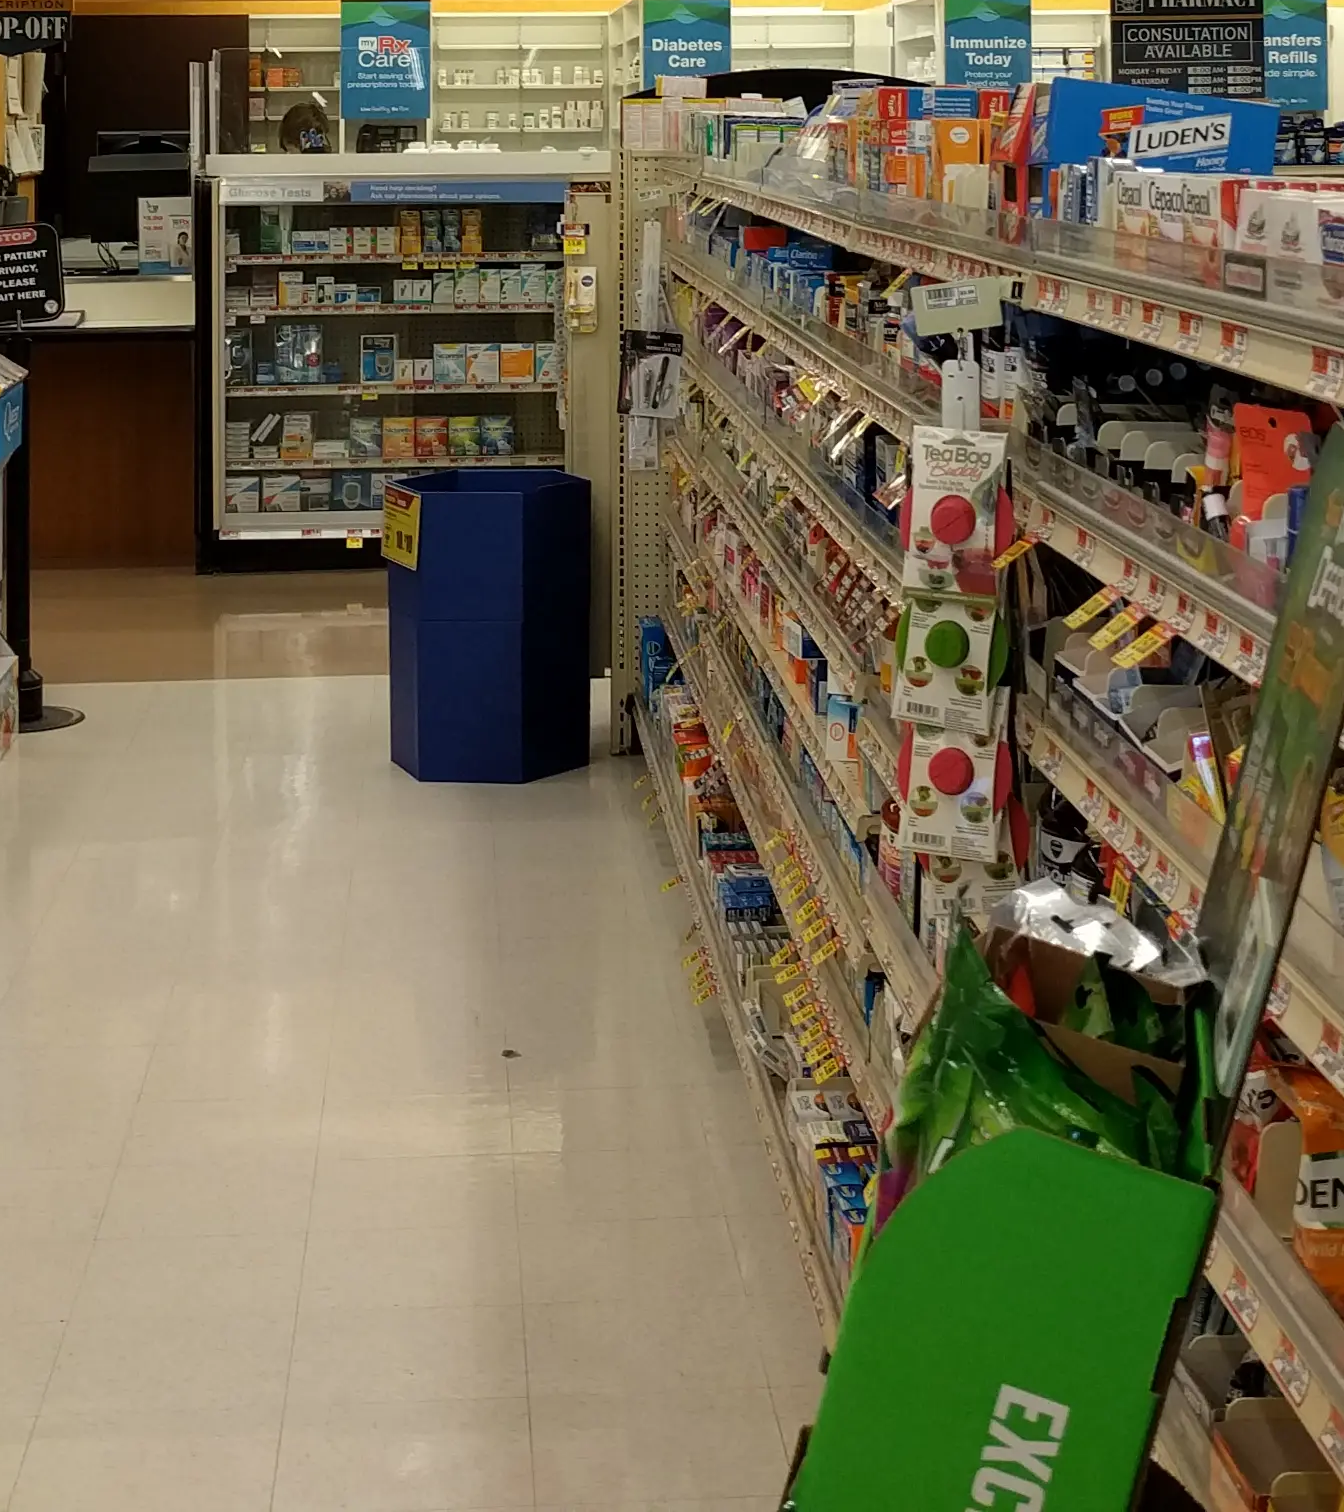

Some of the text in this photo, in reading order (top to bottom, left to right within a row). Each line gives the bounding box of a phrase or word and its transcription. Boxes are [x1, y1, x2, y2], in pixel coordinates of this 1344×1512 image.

[1127, 26, 1249, 42] CONSULTATION
[1264, 34, 1322, 47] ansfers
[377, 35, 412, 55] Rx
[651, 38, 723, 52] Diabetes
[949, 36, 1027, 50] Immunize
[1144, 43, 1233, 59] AVAILABLE
[1268, 50, 1318, 64] Refills
[358, 51, 411, 68] Care
[668, 53, 707, 68] Care
[965, 52, 1012, 68] Today
[964, 71, 1012, 80] Protect your
[1282, 68, 1318, 79] simple.
[1135, 122, 1226, 154] LUDEN'S
[279, 187, 312, 198] Tests
[3, 249, 48, 261] PATIENT
[17, 289, 46, 300] HERE
[965, 1383, 1070, 1512] EXC
